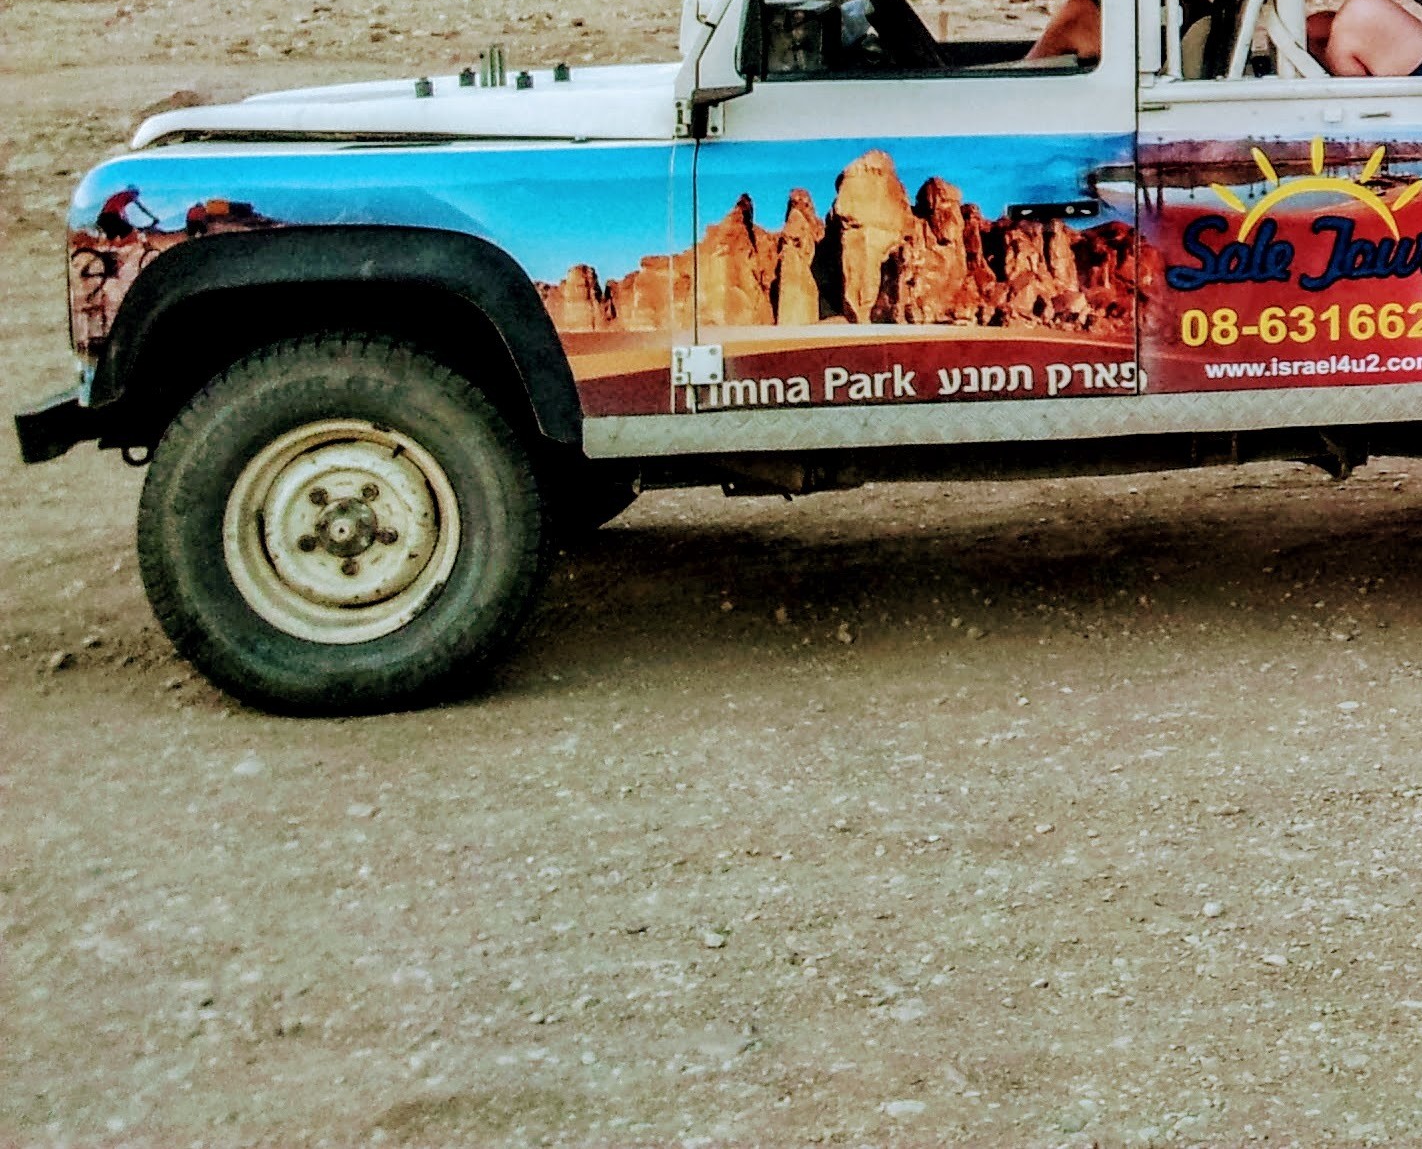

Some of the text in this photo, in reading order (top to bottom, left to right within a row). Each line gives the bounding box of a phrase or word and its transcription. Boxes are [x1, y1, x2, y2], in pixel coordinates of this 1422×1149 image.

[1166, 214, 1295, 291] Sole
[824, 363, 917, 401] Park
[937, 361, 1149, 396] פארק תמנע
